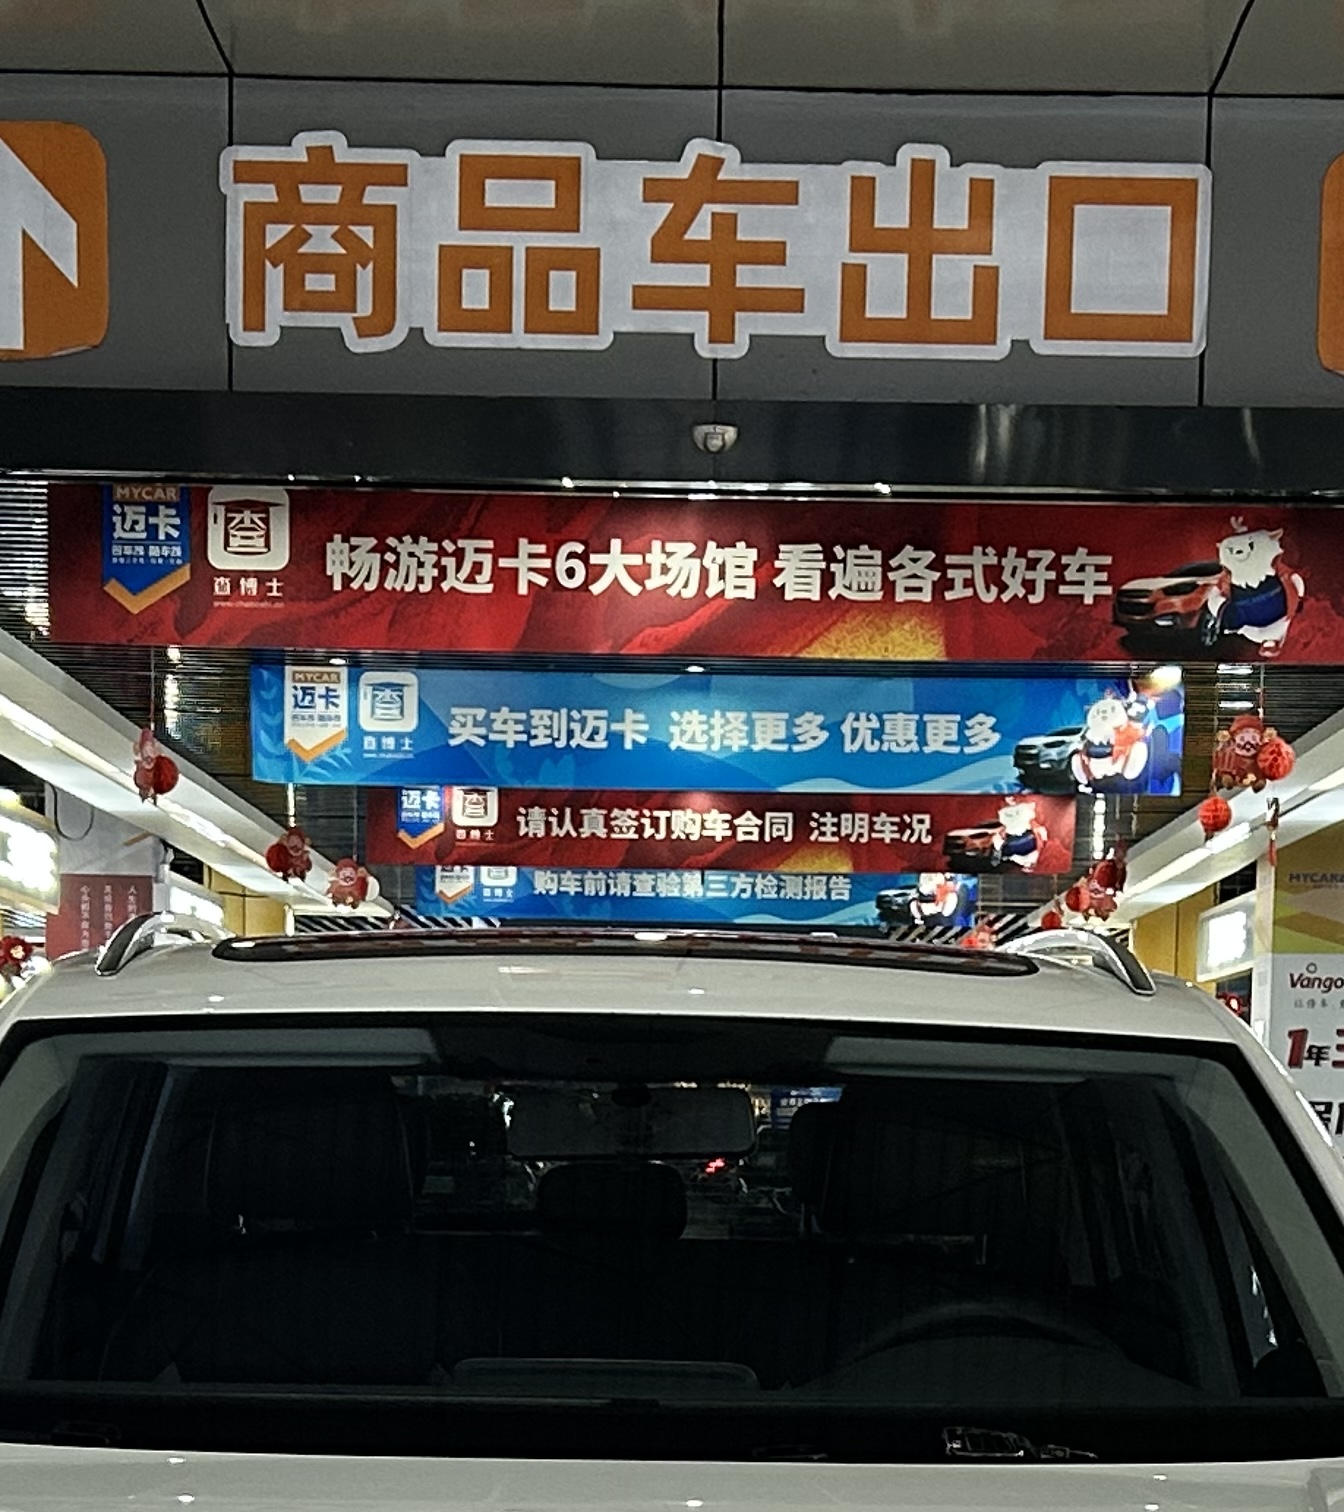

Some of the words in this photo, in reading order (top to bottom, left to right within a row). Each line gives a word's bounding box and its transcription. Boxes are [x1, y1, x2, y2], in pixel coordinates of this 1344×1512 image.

[226, 134, 1209, 356] 商品车出口
[116, 486, 177, 500] MYCAR
[112, 505, 181, 540] 迈卡
[325, 532, 757, 600] 畅游迈卡6大场馆
[773, 543, 1113, 606] 看遍各式好车
[292, 685, 341, 711] 迈卡
[448, 706, 650, 751] 买车到迈卡
[668, 709, 830, 754] 选择更多
[840, 710, 1002, 756] 优惠更多
[516, 806, 795, 843] 请认真签订购车合同
[809, 811, 933, 844] 注明车况
[533, 869, 853, 901] 购车前请查验第三方检测报告
